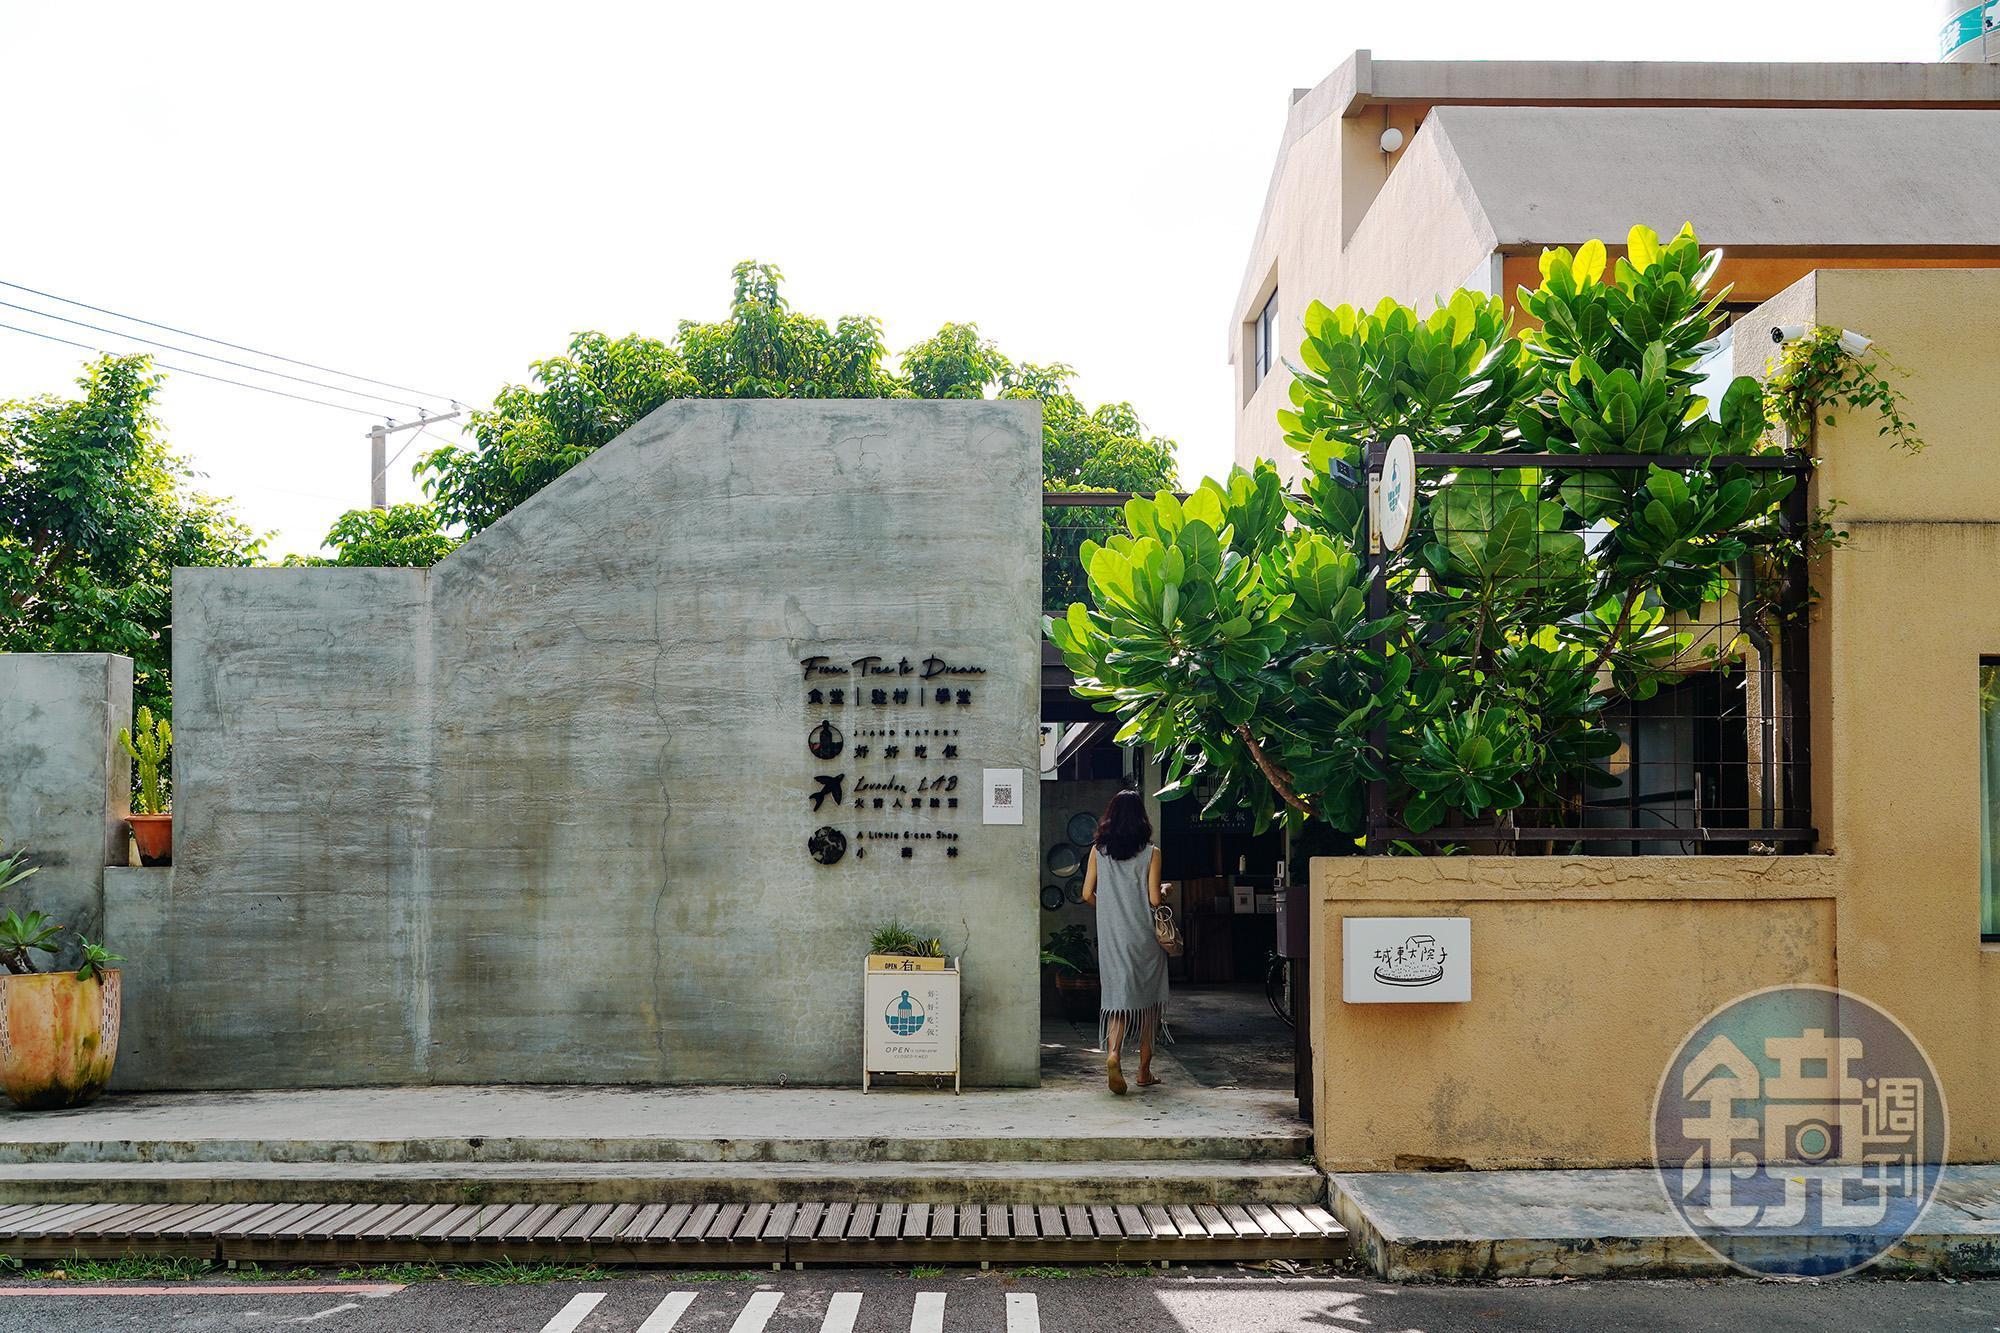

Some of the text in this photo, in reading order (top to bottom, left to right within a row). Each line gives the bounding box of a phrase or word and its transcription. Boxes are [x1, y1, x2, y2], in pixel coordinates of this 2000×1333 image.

[800, 654, 986, 680] From Tree to Dream
[808, 688, 845, 705] 食堂
[917, 775, 959, 792] LAB
[856, 831, 959, 842] A Little Green Shop
[885, 962, 898, 970] OPEN
[1373, 947, 1448, 969] 城東大院子
